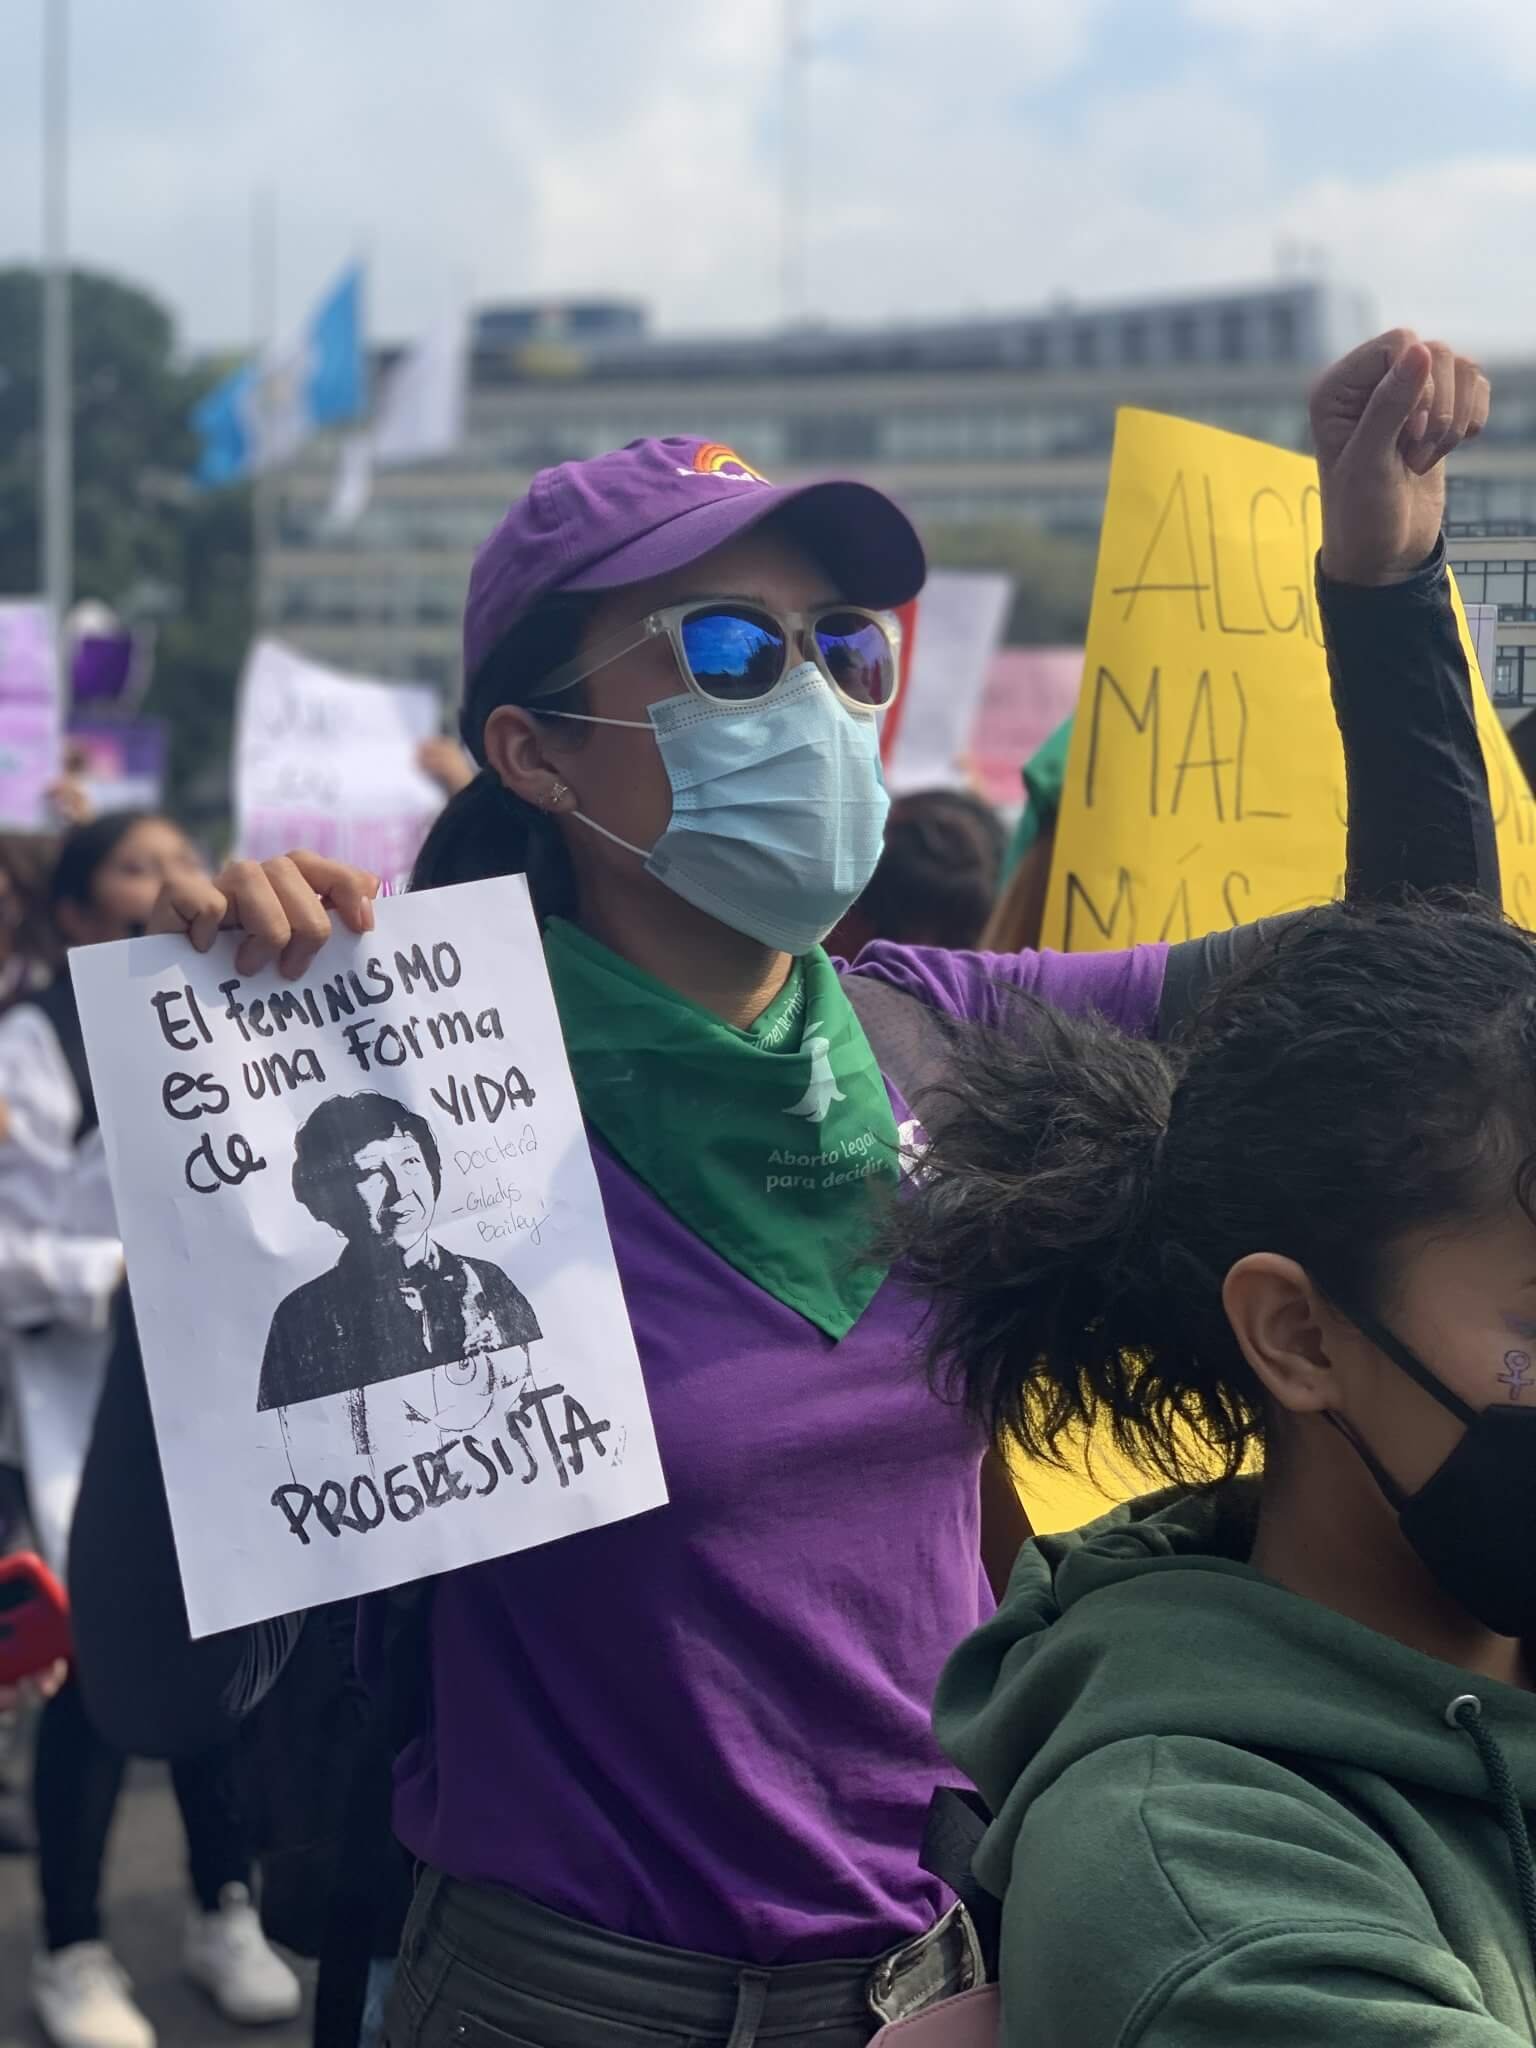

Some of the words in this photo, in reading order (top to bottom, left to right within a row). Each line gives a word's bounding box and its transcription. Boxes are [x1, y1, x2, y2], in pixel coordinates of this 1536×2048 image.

[1086, 664, 1292, 823] MAL
[150, 983, 214, 1051] El
[162, 1071, 230, 1120] es
[242, 1048, 327, 1100] una
[184, 1132, 268, 1194] de
[429, 1065, 537, 1126] VIDA
[767, 1148, 840, 1168] Aborto
[840, 1126, 877, 1159] legal
[766, 1174, 816, 1193] para
